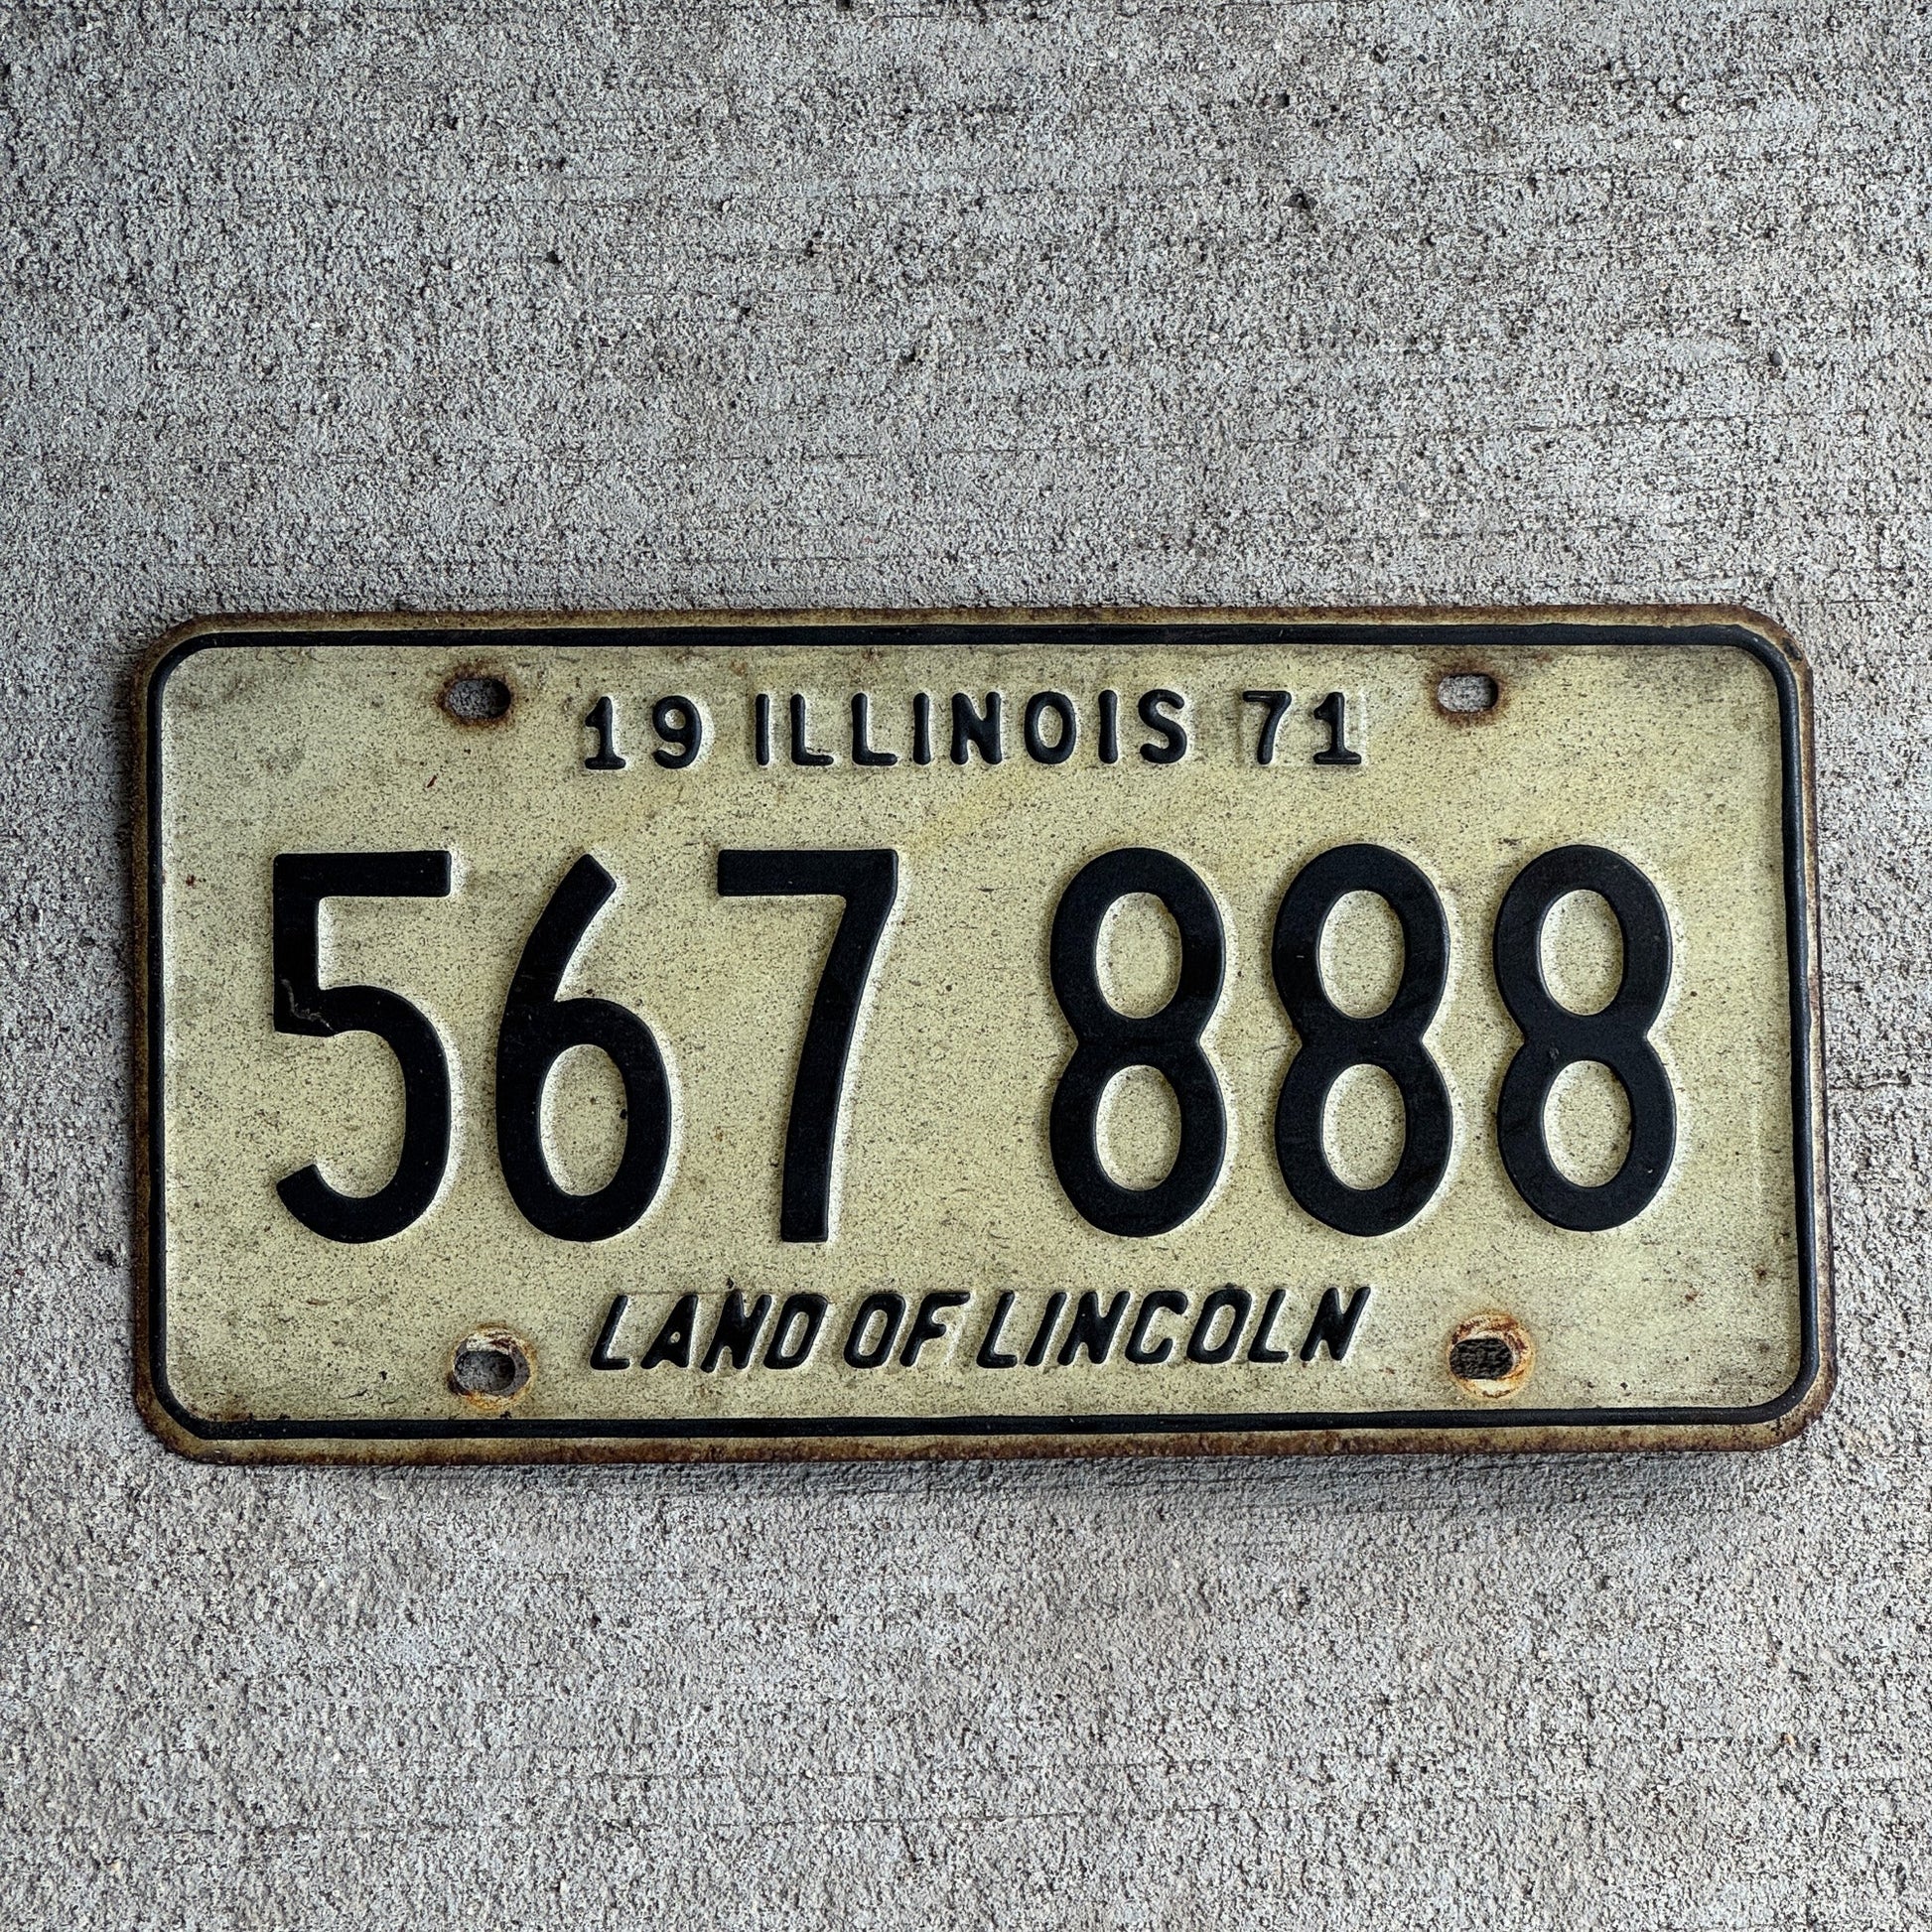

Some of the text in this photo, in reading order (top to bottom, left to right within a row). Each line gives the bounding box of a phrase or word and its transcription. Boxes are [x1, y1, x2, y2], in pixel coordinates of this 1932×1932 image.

[584, 688, 1363, 770] 19 ILLINOIS 71
[272, 843, 1676, 1245] 567 888
[589, 1286, 1372, 1373] LAND OF LINCOLN
